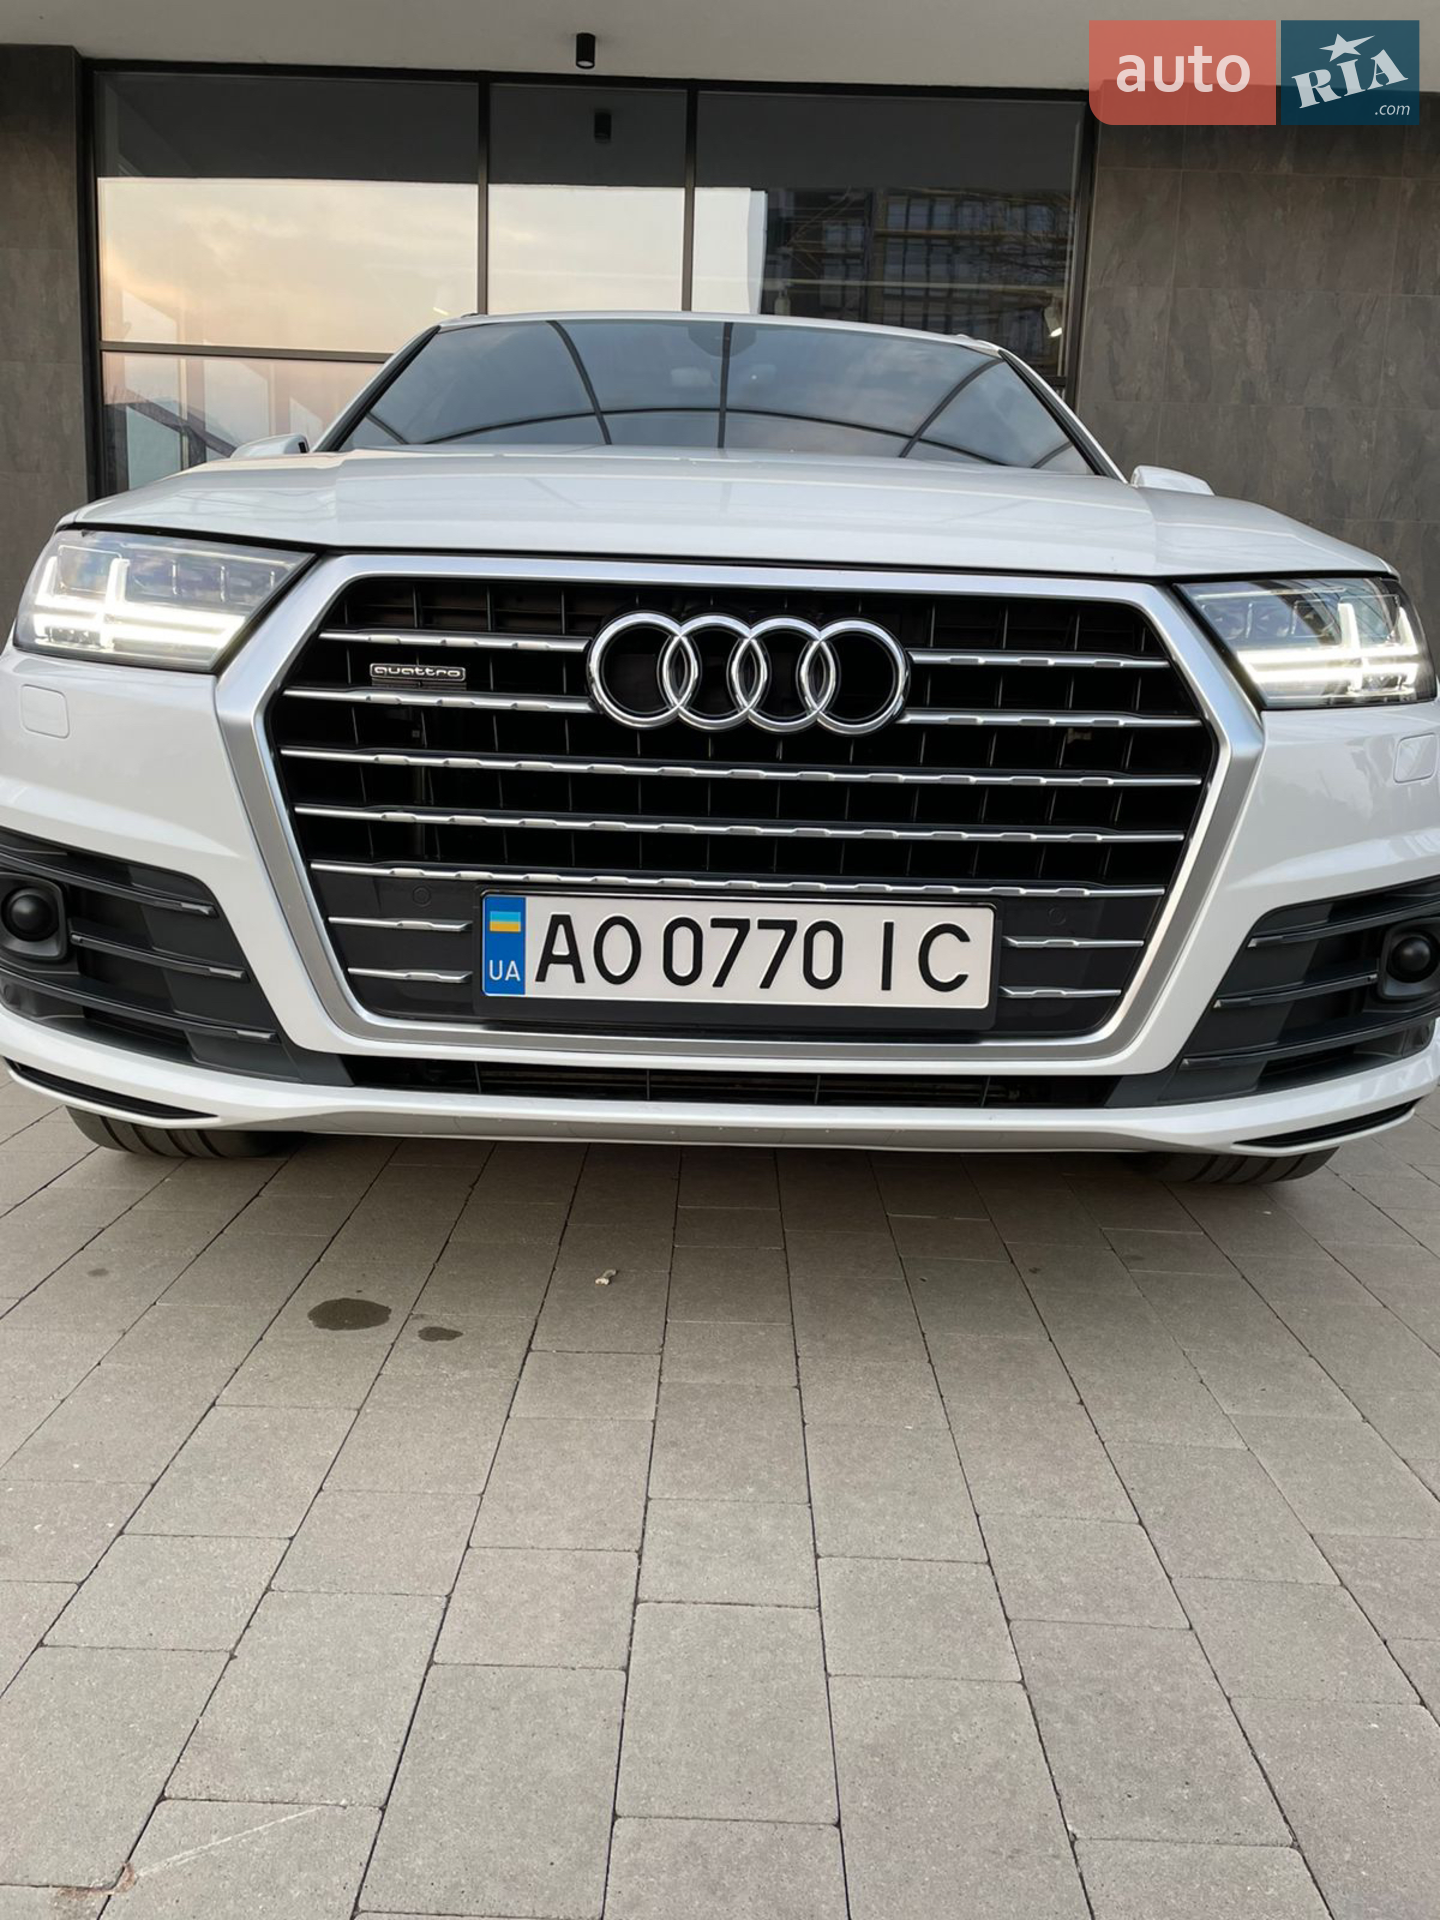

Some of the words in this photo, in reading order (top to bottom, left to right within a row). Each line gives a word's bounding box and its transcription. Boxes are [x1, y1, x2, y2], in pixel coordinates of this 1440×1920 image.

[373, 666, 461, 678] quattro
[534, 913, 642, 985] AO
[662, 916, 844, 990] 0770
[880, 920, 972, 993] IC
[488, 959, 522, 982] UA
